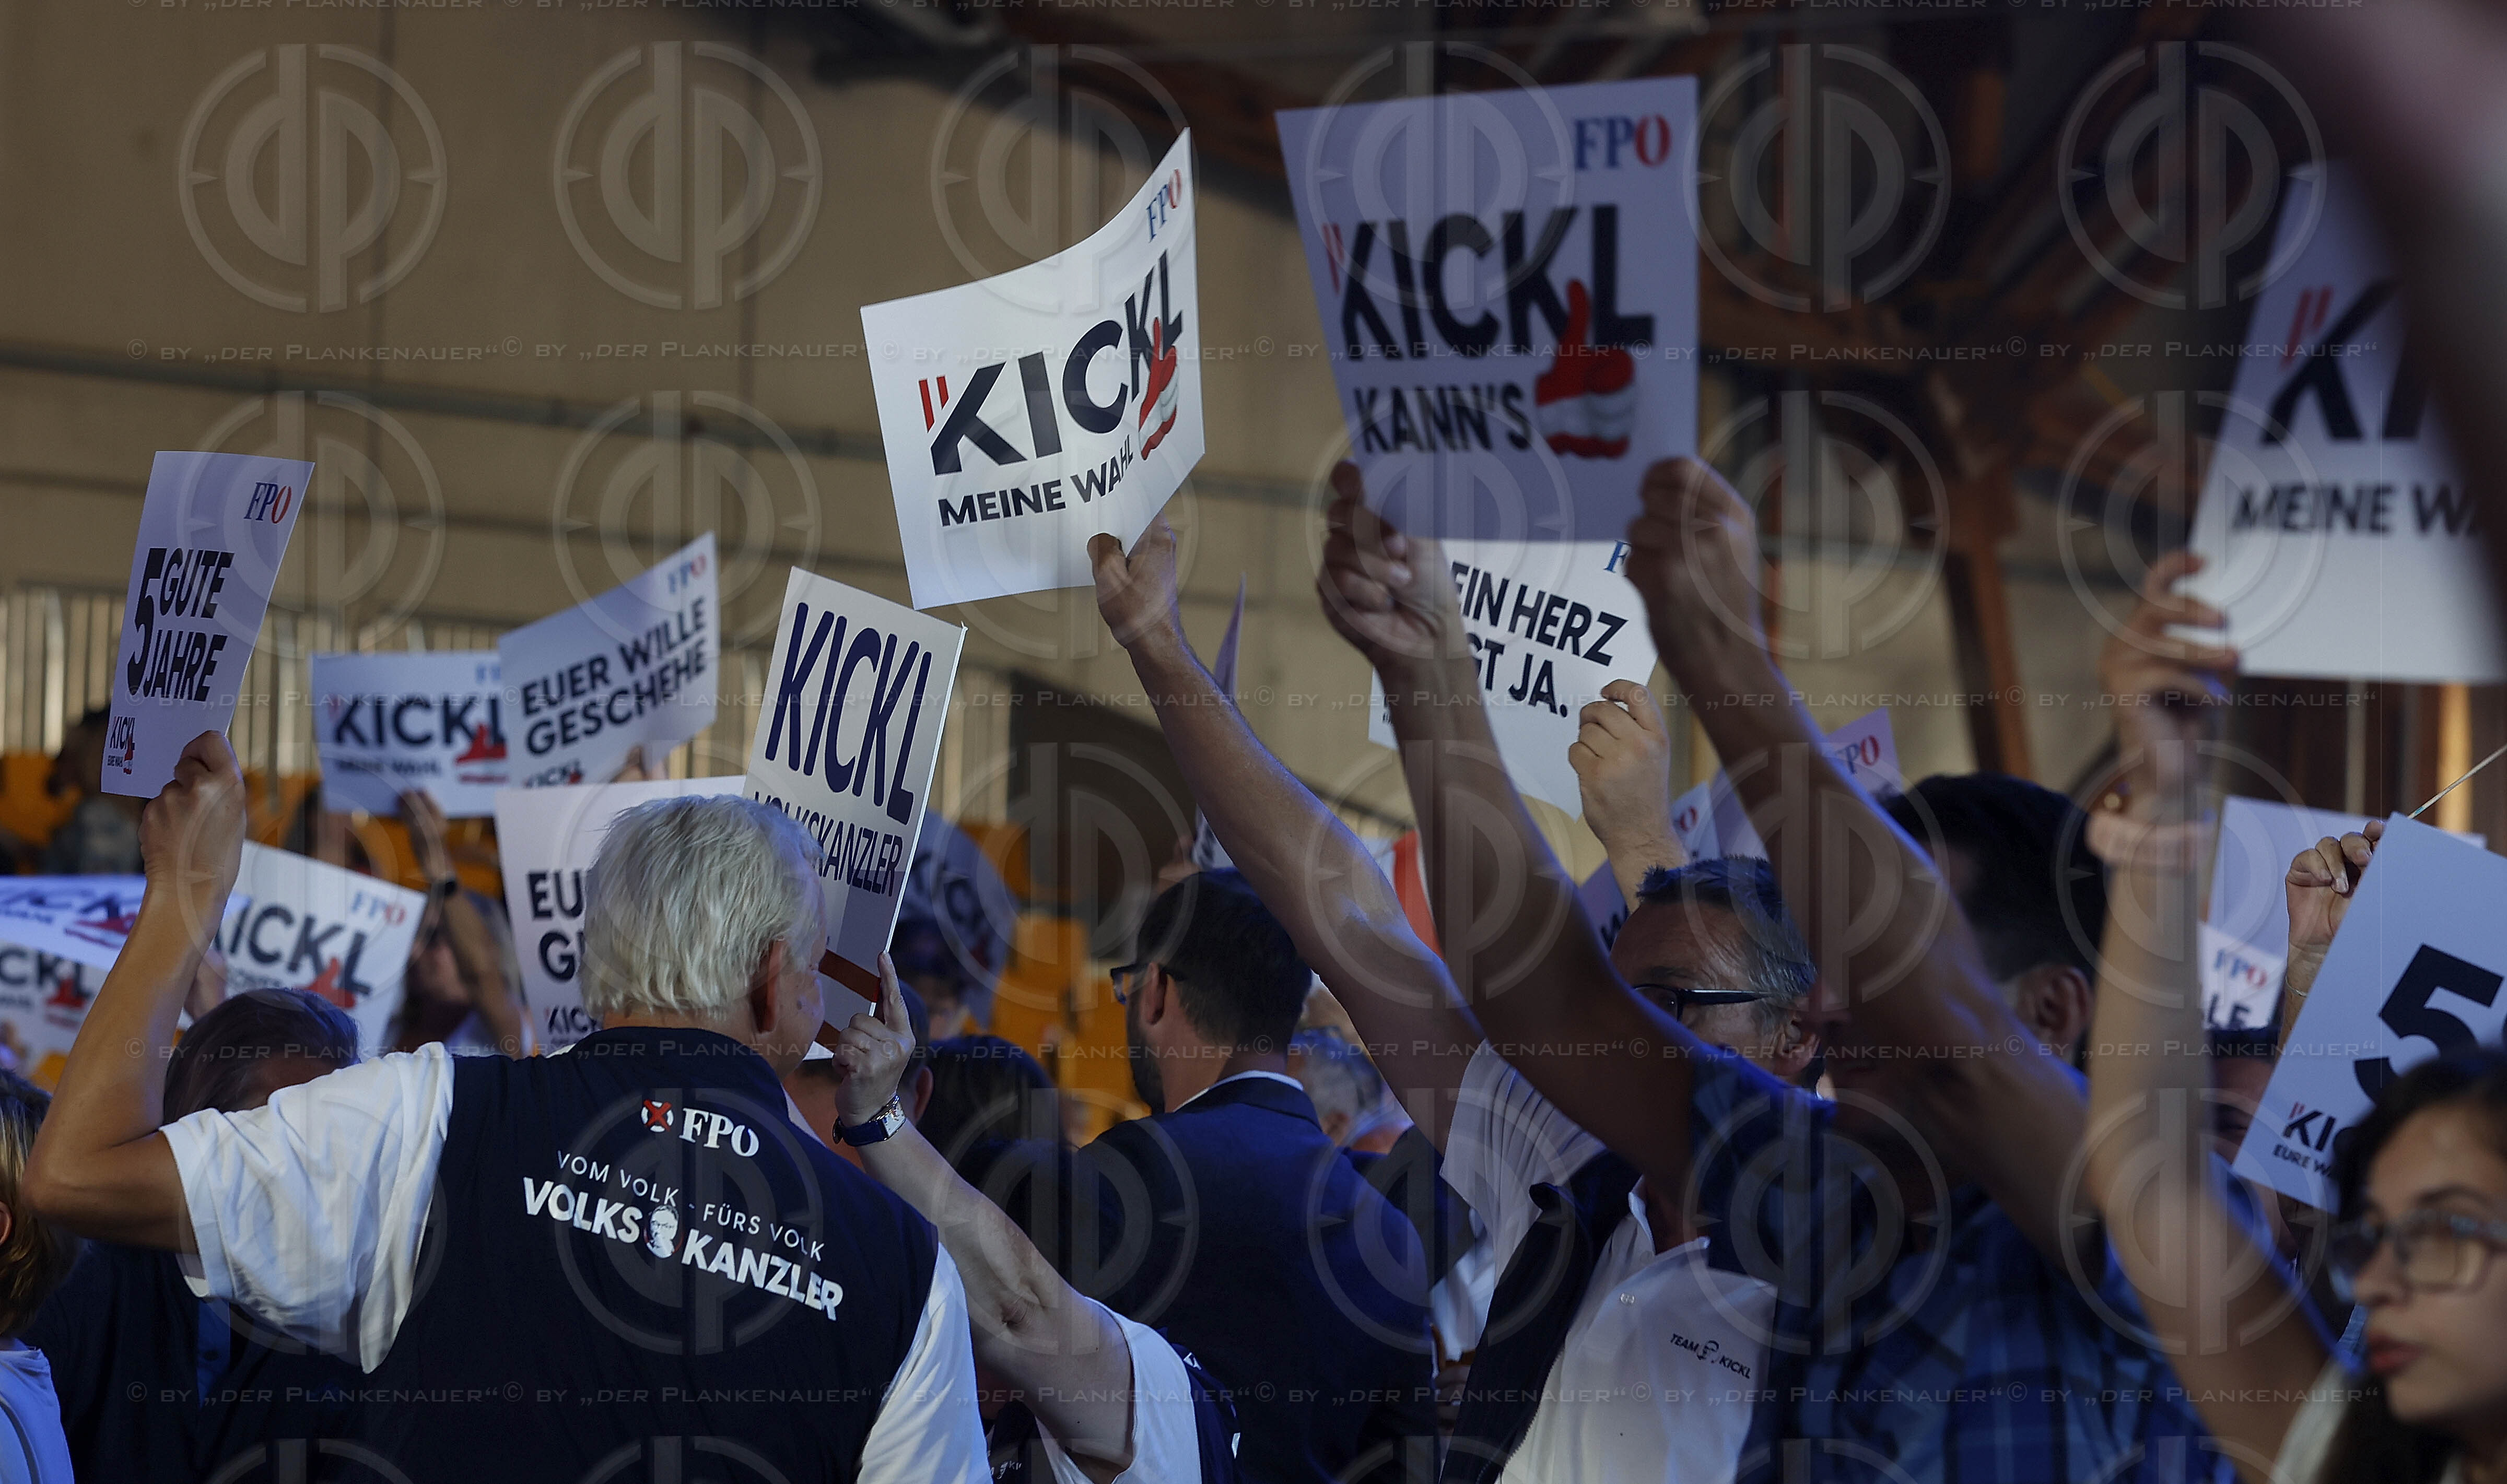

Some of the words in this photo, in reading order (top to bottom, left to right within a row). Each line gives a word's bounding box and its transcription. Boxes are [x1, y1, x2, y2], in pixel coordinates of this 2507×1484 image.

[1322, 204, 1656, 362] KICKL
[918, 249, 1183, 476] KICKL
[1354, 380, 1533, 453] KANN'S
[938, 479, 1067, 528] MEINE
[1070, 433, 1133, 504] WAHL
[2229, 478, 2392, 536] MEINE
[2410, 479, 2478, 539] W
[127, 548, 167, 696] 5
[159, 548, 235, 619] GUTE
[522, 654, 611, 716] EUER
[618, 597, 706, 674] WILLE
[1509, 584, 1629, 667] HERZ
[143, 629, 228, 702] JAHRE
[526, 640, 706, 755] GESCHEHE
[1508, 653, 1569, 719] JA.
[110, 716, 135, 750] KICKL
[331, 693, 507, 747] KICKL
[765, 602, 933, 826] KICKL
[528, 871, 584, 920] EU
[213, 903, 372, 997] ICKL
[2272, 1144, 2311, 1169] EURE
[2314, 1159, 2332, 1177] W
[2283, 1102, 2337, 1152] KI
[557, 1149, 610, 1184] VOM
[619, 1169, 681, 1208] VOLK
[702, 1203, 761, 1236] FÜRS
[769, 1222, 826, 1263] VOLK
[522, 1176, 641, 1245] VOLKS
[682, 1228, 844, 1322] KANZLER
[1670, 1333, 1700, 1355] TEAM
[1718, 1355, 1751, 1380] KICKL
